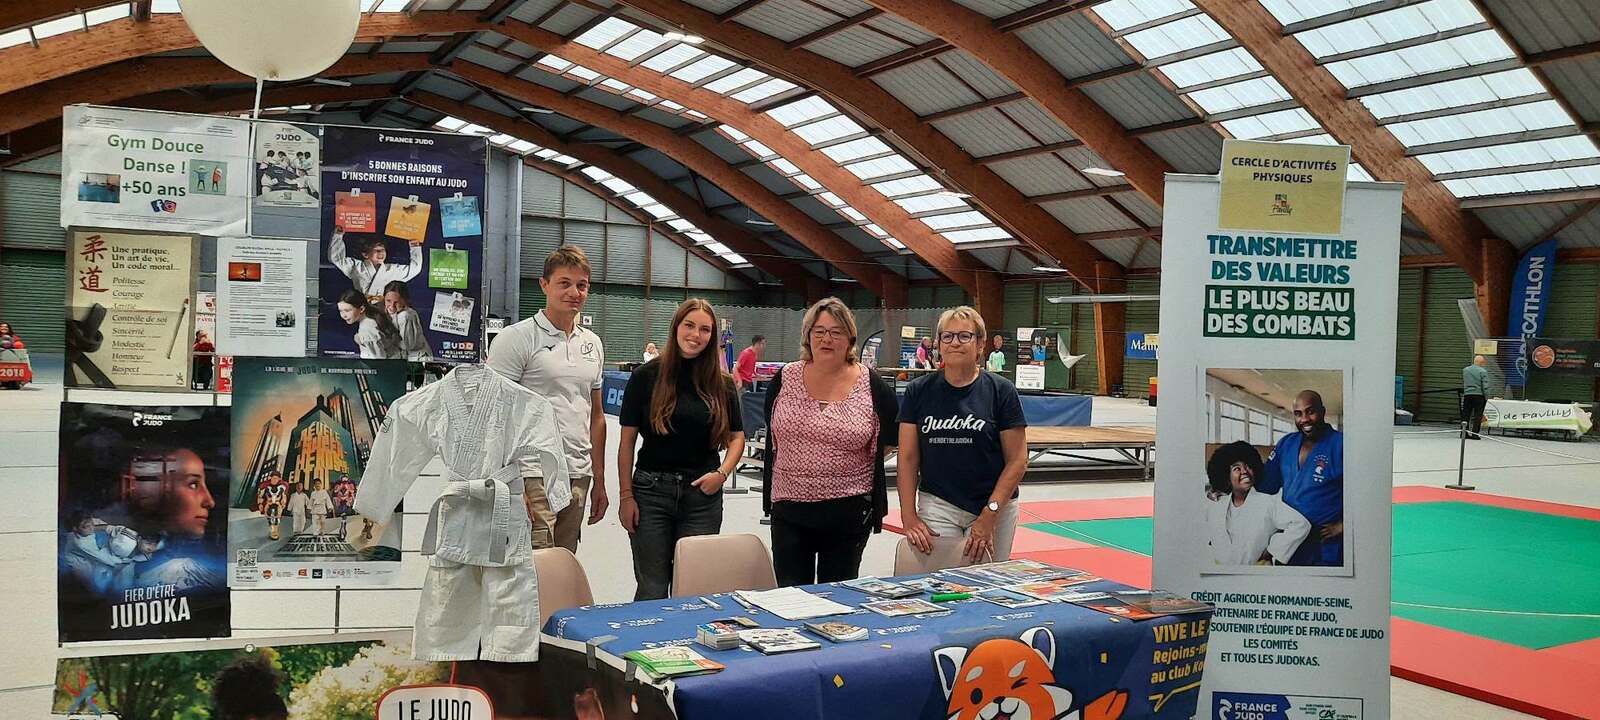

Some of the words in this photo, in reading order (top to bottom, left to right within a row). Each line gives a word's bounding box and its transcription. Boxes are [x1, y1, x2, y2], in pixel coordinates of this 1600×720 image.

[108, 134, 146, 150] Gym
[152, 138, 204, 153] Douce
[385, 136, 413, 144] FRANCE
[124, 158, 175, 174] Danse
[369, 160, 374, 169] 5
[375, 161, 406, 171] BONNES
[408, 163, 442, 174] RAISONS
[1232, 157, 1270, 168] CERCLE
[388, 174, 405, 184] SON
[406, 175, 436, 186] ENFANT
[436, 178, 446, 186] AU
[448, 178, 468, 188] JUDO
[1253, 172, 1313, 184] PHYSIQUES
[122, 181, 152, 194] +50
[158, 185, 186, 196] ans
[112, 246, 130, 254] Une
[1206, 234, 1358, 260] TRANSMETTRE
[80, 234, 109, 293] 柔道
[112, 254, 125, 262] Un
[128, 262, 147, 270] code
[1212, 261, 1252, 281] DES
[1257, 262, 1350, 285] VALEURS
[112, 290, 144, 300] Courage
[1209, 289, 1232, 310] LE
[1237, 290, 1290, 310] PLUS
[1294, 292, 1350, 312] BEAU
[1208, 313, 1248, 334] DES
[1252, 314, 1350, 336] COMBATS
[112, 366, 140, 374] Respect
[922, 414, 986, 434] Judoka
[125, 588, 144, 602] FIER
[146, 583, 176, 600] D'ÊTRE
[1191, 590, 1222, 602] CRÉDIT
[1224, 594, 1266, 604] AGRICOLE
[1268, 595, 1352, 609] NORMANDIE-SEINE,
[110, 597, 191, 630] JUDOKA
[1261, 610, 1272, 620] DE
[1274, 610, 1310, 622] FRANCE
[1311, 612, 1338, 624] JUDO,
[1153, 622, 1187, 643] VIVE
[1191, 620, 1205, 637] LE
[1210, 622, 1254, 634] SOUTENIR
[1296, 626, 1307, 636] DE
[1309, 627, 1344, 638] FRANCE
[1346, 628, 1358, 638] DE
[1360, 629, 1384, 640] JUDO
[1244, 638, 1258, 649] LES
[1260, 638, 1298, 650] COMITÉS
[1220, 652, 1232, 662] ET
[1234, 653, 1256, 664] TOUS
[1258, 654, 1273, 664] LES
[1275, 655, 1320, 666] JUDOKAS.
[1151, 671, 1166, 684] au
[1168, 664, 1190, 680] club
[399, 700, 420, 720] LE
[429, 698, 472, 720] JUDO
[1234, 702, 1278, 712] FRANCE
[1234, 711, 1264, 720] JUDO
